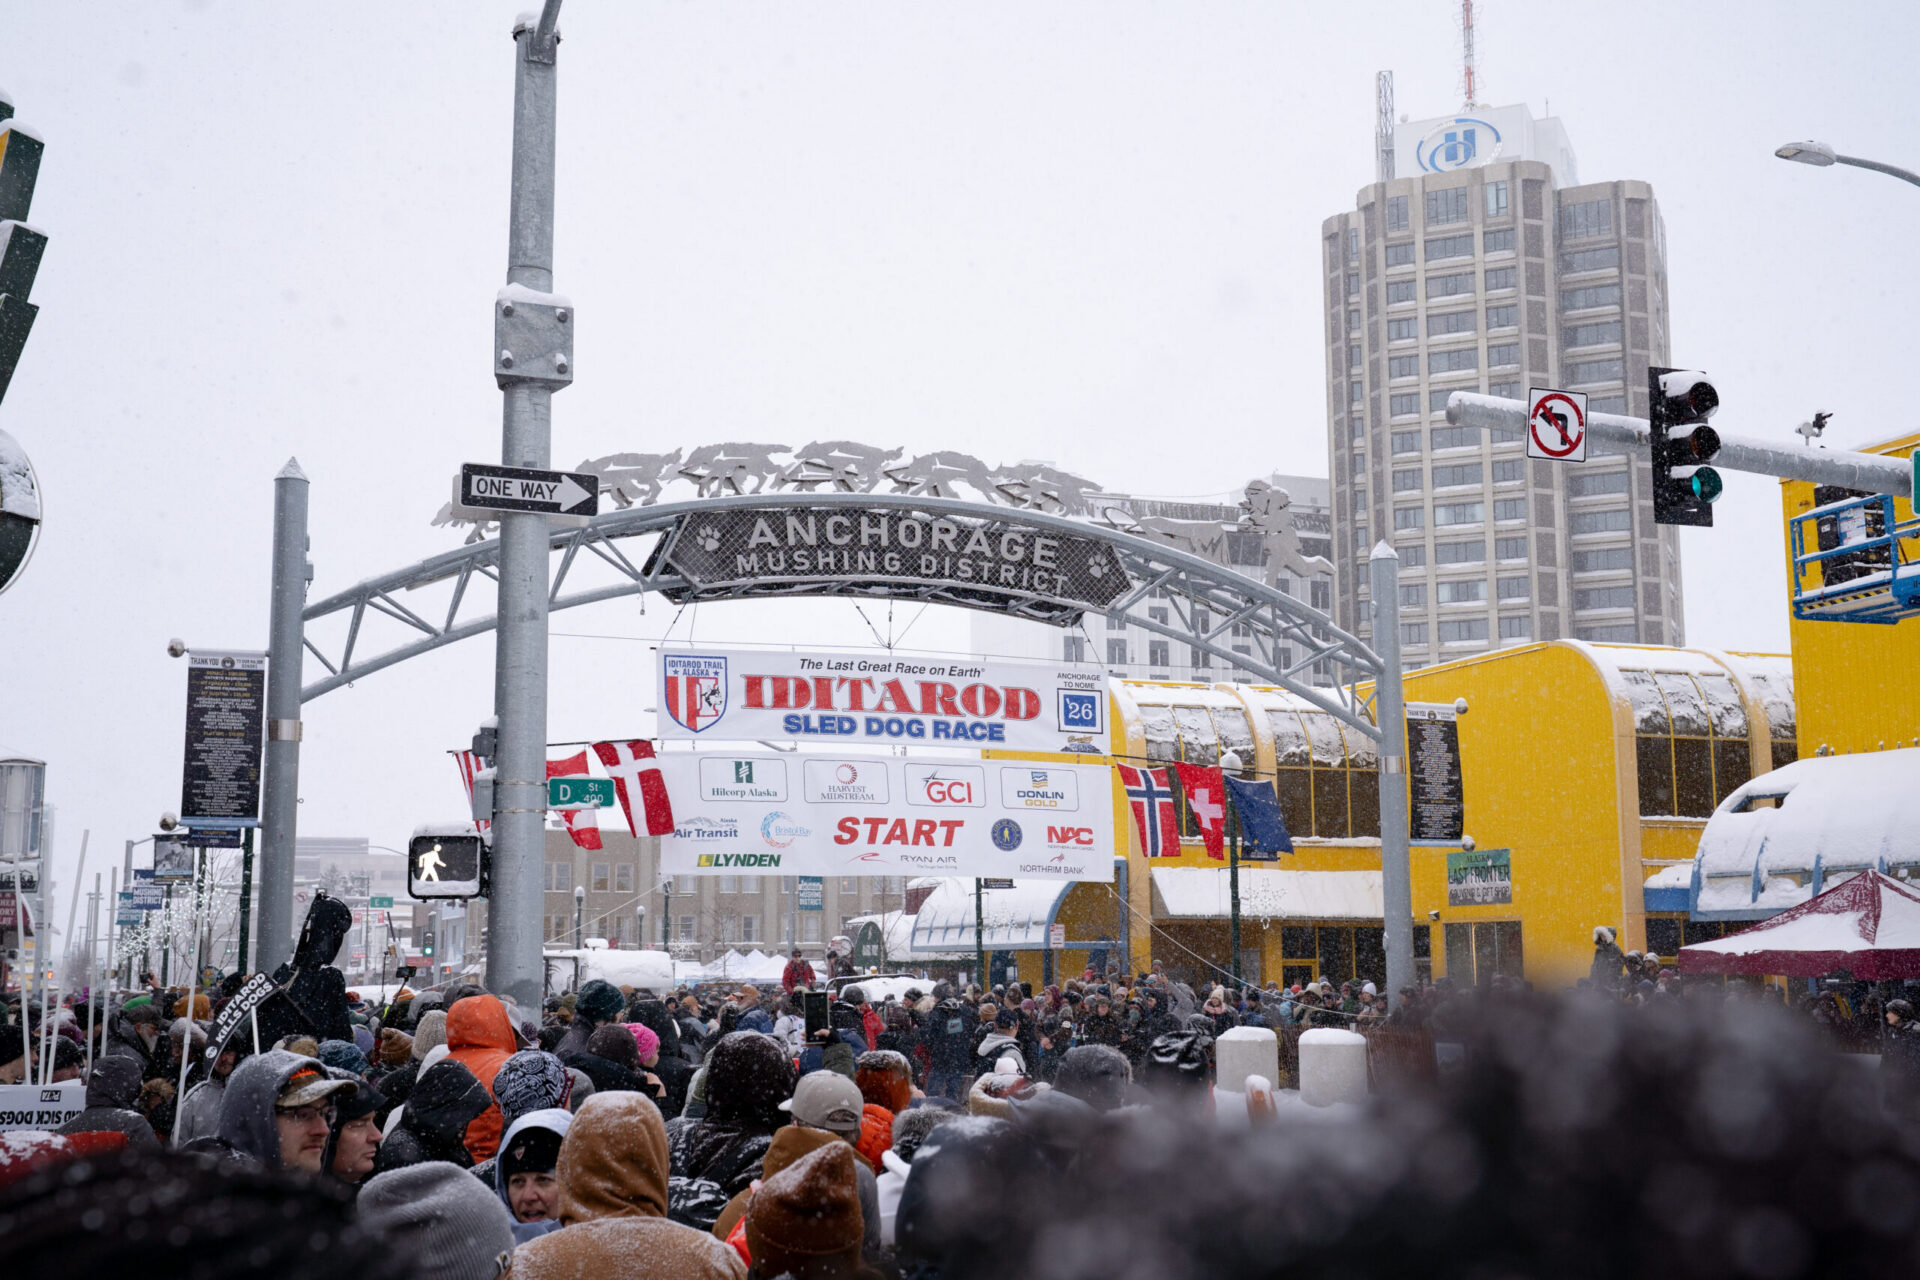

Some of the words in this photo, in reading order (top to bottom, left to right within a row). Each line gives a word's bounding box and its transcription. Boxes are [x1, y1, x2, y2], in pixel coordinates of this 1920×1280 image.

[476, 477, 513, 497] ONE
[520, 481, 558, 500] WAY
[747, 513, 1060, 570] ANCHORAGE
[736, 549, 902, 576] MUSHING
[919, 553, 1070, 595] DISTRICT
[190, 656, 208, 665] THANK
[209, 657, 220, 666] YOU
[668, 660, 702, 669] IDITAROD
[703, 661, 724, 670] TRAIL
[682, 668, 710, 677] ALASKA
[800, 658, 823, 670] The
[826, 659, 854, 671] Last
[857, 660, 892, 673] Great
[894, 662, 926, 675] Race
[930, 666, 946, 676] on
[1057, 672, 1101, 681] ANCHORAGE
[1074, 682, 1096, 690] NOME
[740, 673, 1042, 721] IDITAROD
[783, 713, 858, 737] SLED
[864, 715, 926, 739] DOG
[932, 719, 1006, 743] RACE
[559, 784, 571, 801] D
[588, 782, 599, 792] St
[828, 785, 867, 793] HARVEST
[926, 781, 973, 804] GCI
[711, 787, 747, 799] Hilcorp
[748, 788, 778, 798] Alaska
[820, 792, 875, 801] MIDSTREAM
[1017, 790, 1065, 800] DONLIN
[1025, 798, 1058, 808] GOLD
[673, 827, 692, 838] Air
[694, 827, 738, 838] Transit
[833, 816, 965, 847] START
[1047, 825, 1094, 846] NAC
[714, 853, 782, 868] LYNDEN
[900, 854, 933, 863] RYAN
[1466, 854, 1491, 863] ALASKA
[1019, 864, 1062, 874] NORTHRIM
[1063, 866, 1084, 875] BANK
[1447, 866, 1468, 885] LAST
[1470, 864, 1510, 884] FRONTIER
[132, 887, 163, 897] MUSHING
[1482, 886, 1495, 897] GIFT
[1494, 886, 1510, 897] SHOP
[132, 896, 162, 905] DISTRICT
[216, 973, 266, 1026] IDITAROD
[215, 1009, 243, 1043] KILLS
[240, 981, 274, 1012] DOGS
[0, 1110, 34, 1125] DOGS
[36, 1110, 63, 1125] SICK
